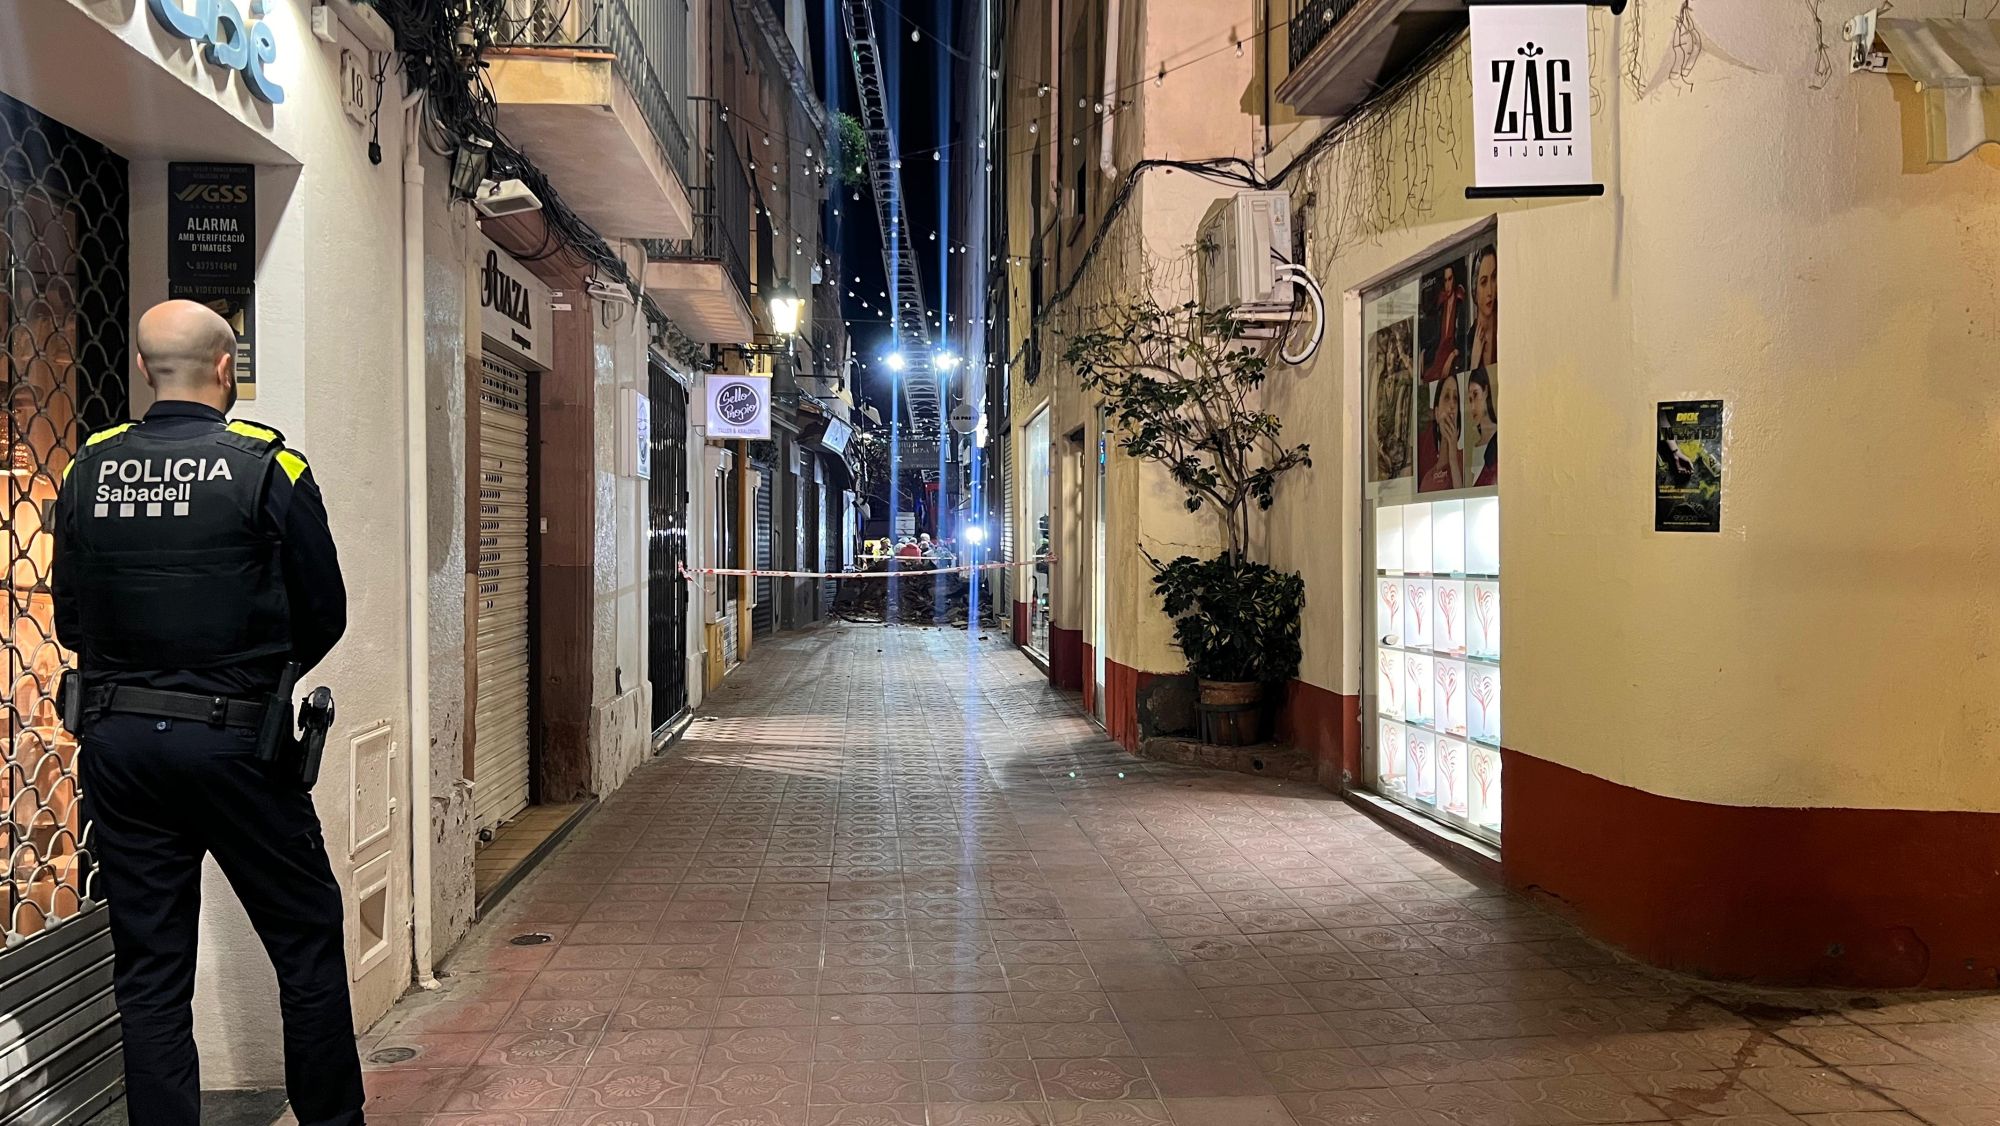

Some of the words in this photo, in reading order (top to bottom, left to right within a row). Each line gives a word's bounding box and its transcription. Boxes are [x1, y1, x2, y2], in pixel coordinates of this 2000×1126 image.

[351, 66, 364, 109] 18
[1491, 59, 1573, 140] ZAG
[1493, 145, 1573, 158] BIJOUX
[201, 184, 248, 203] GSS
[187, 217, 238, 232] ALARMA
[178, 233, 195, 242] AMB
[196, 233, 245, 243] VERIFICACIÓ
[191, 243, 232, 253] D'IMATGES
[173, 285, 194, 294] ZONA
[721, 387, 750, 405] Sello
[724, 404, 756, 420] Propio
[98, 458, 232, 484] POLICIA
[96, 483, 191, 502] Sabadell
